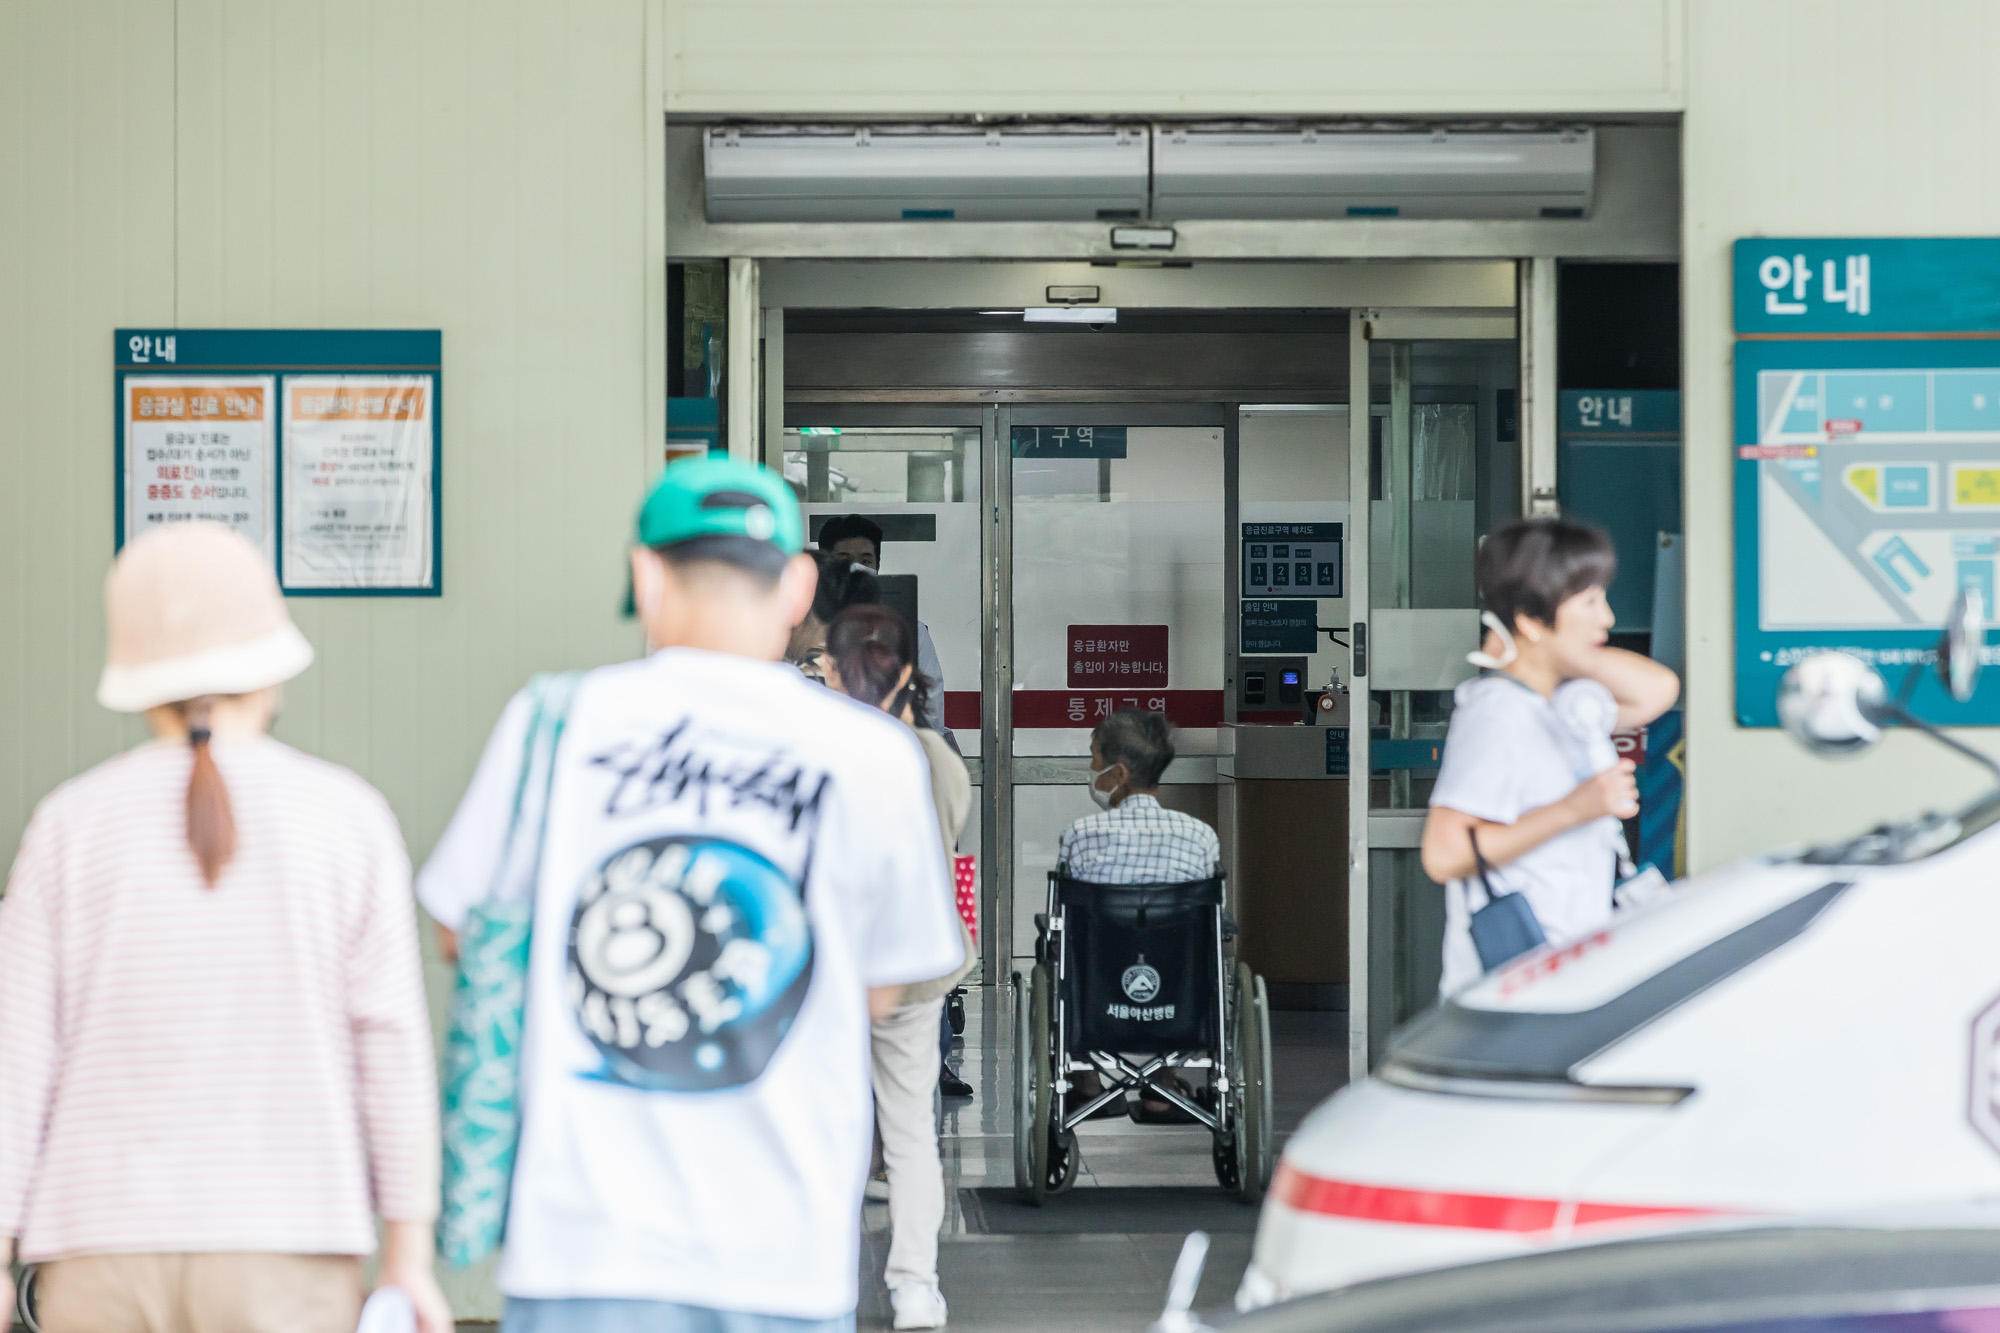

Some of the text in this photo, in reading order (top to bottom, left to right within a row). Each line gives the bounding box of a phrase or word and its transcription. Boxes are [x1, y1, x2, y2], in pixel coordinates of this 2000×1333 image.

[1758, 253, 1871, 316] 안내
[128, 335, 177, 363] 안내
[1578, 396, 1632, 427] 안내
[1245, 526, 1314, 535] 응급진료구역 배치도
[1278, 566, 1284, 575] 2
[1300, 566, 1307, 575] 3
[1323, 566, 1329, 575] 4
[1245, 602, 1278, 612] 출입 안내
[1074, 639, 1130, 653] 응급환자만
[1074, 661, 1166, 674] 출입이 가능합니다.
[1329, 730, 1345, 739] 안내
[1106, 1003, 1175, 1021] 서울아산병원
